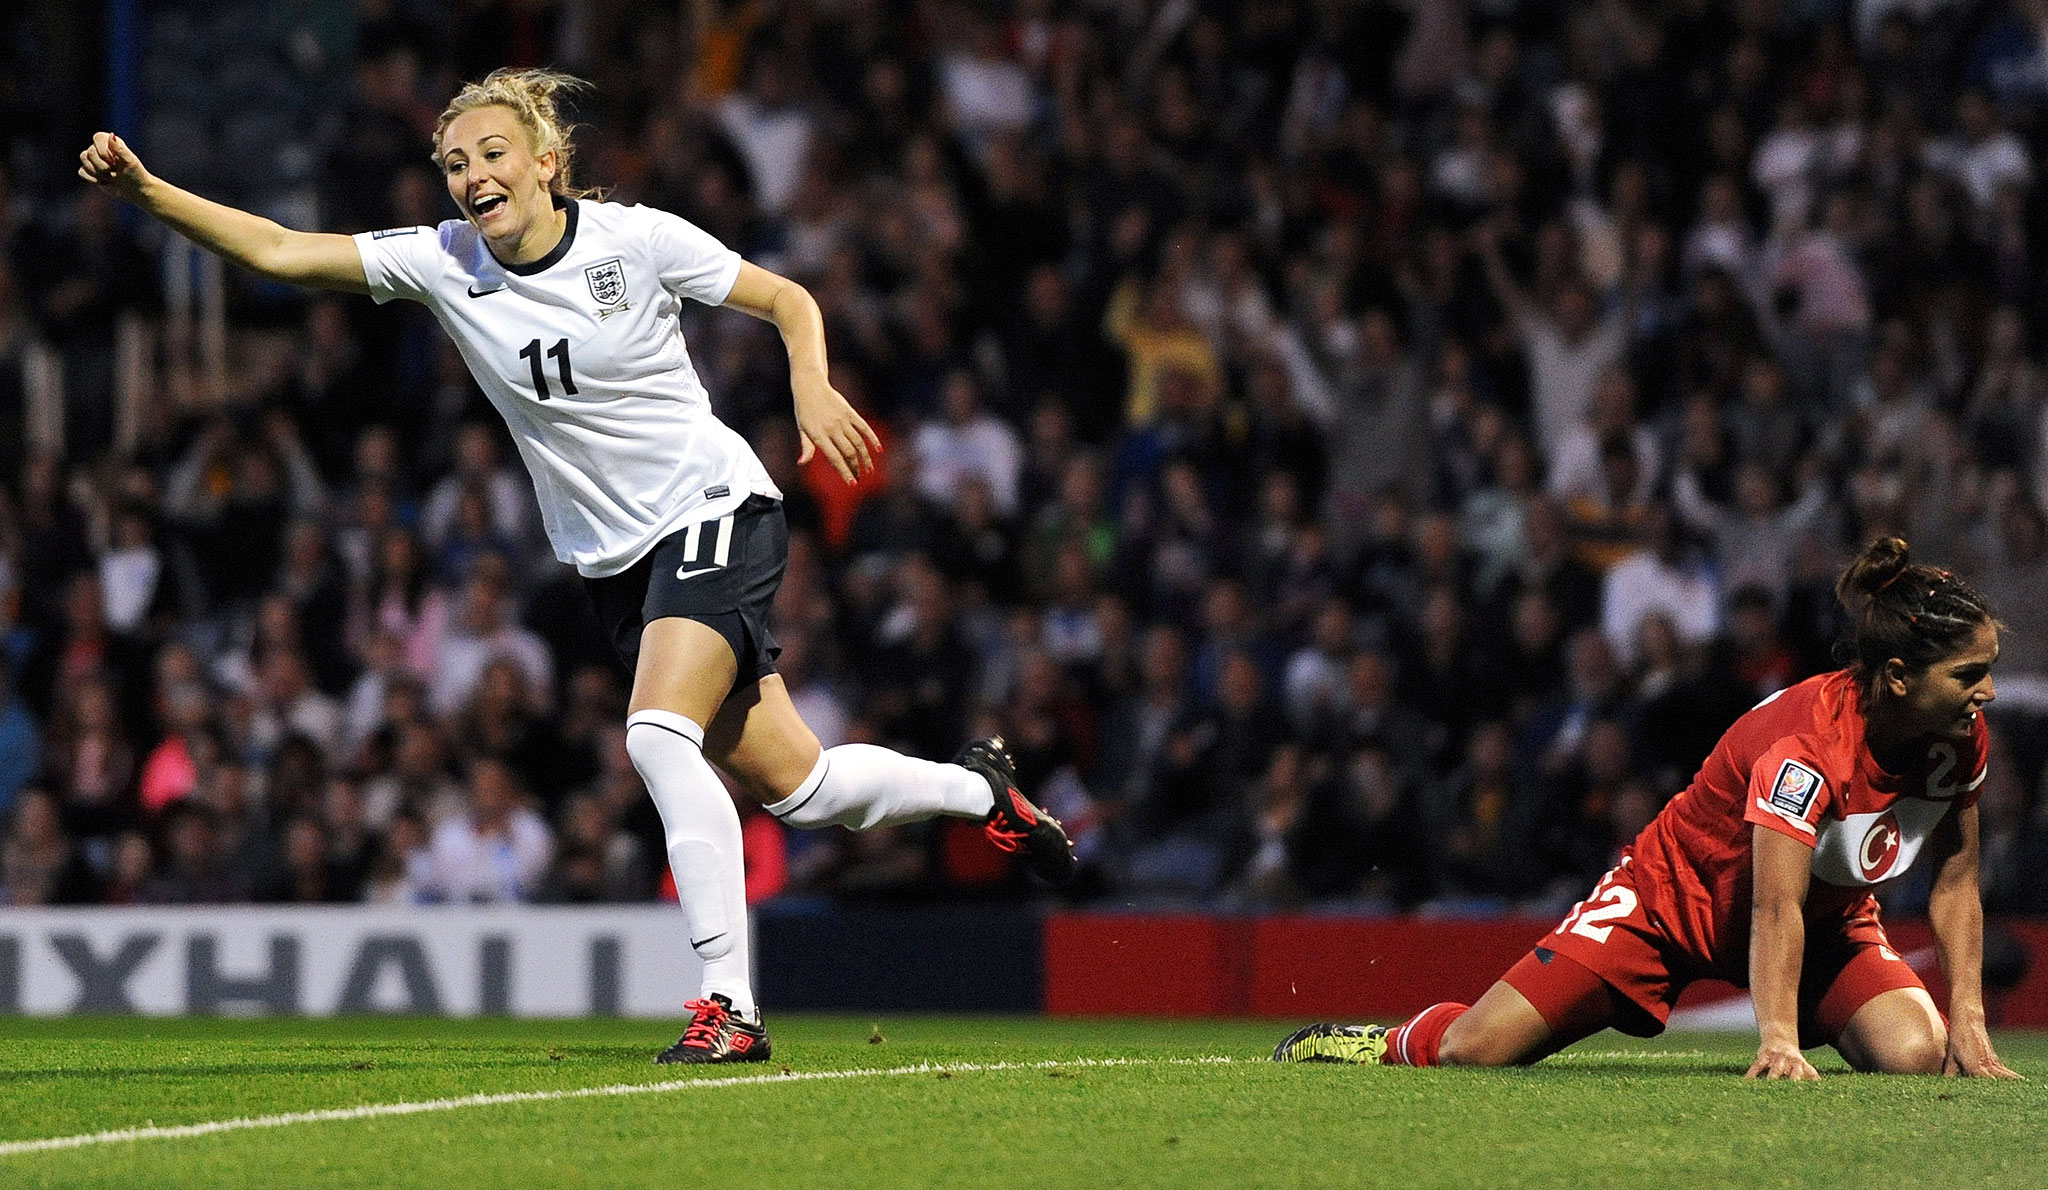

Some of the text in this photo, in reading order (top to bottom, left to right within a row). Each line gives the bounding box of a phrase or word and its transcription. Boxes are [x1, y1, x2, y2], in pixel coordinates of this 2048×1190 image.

[519, 338, 579, 401] 11
[683, 513, 735, 568] 11
[1926, 742, 1958, 797] 2
